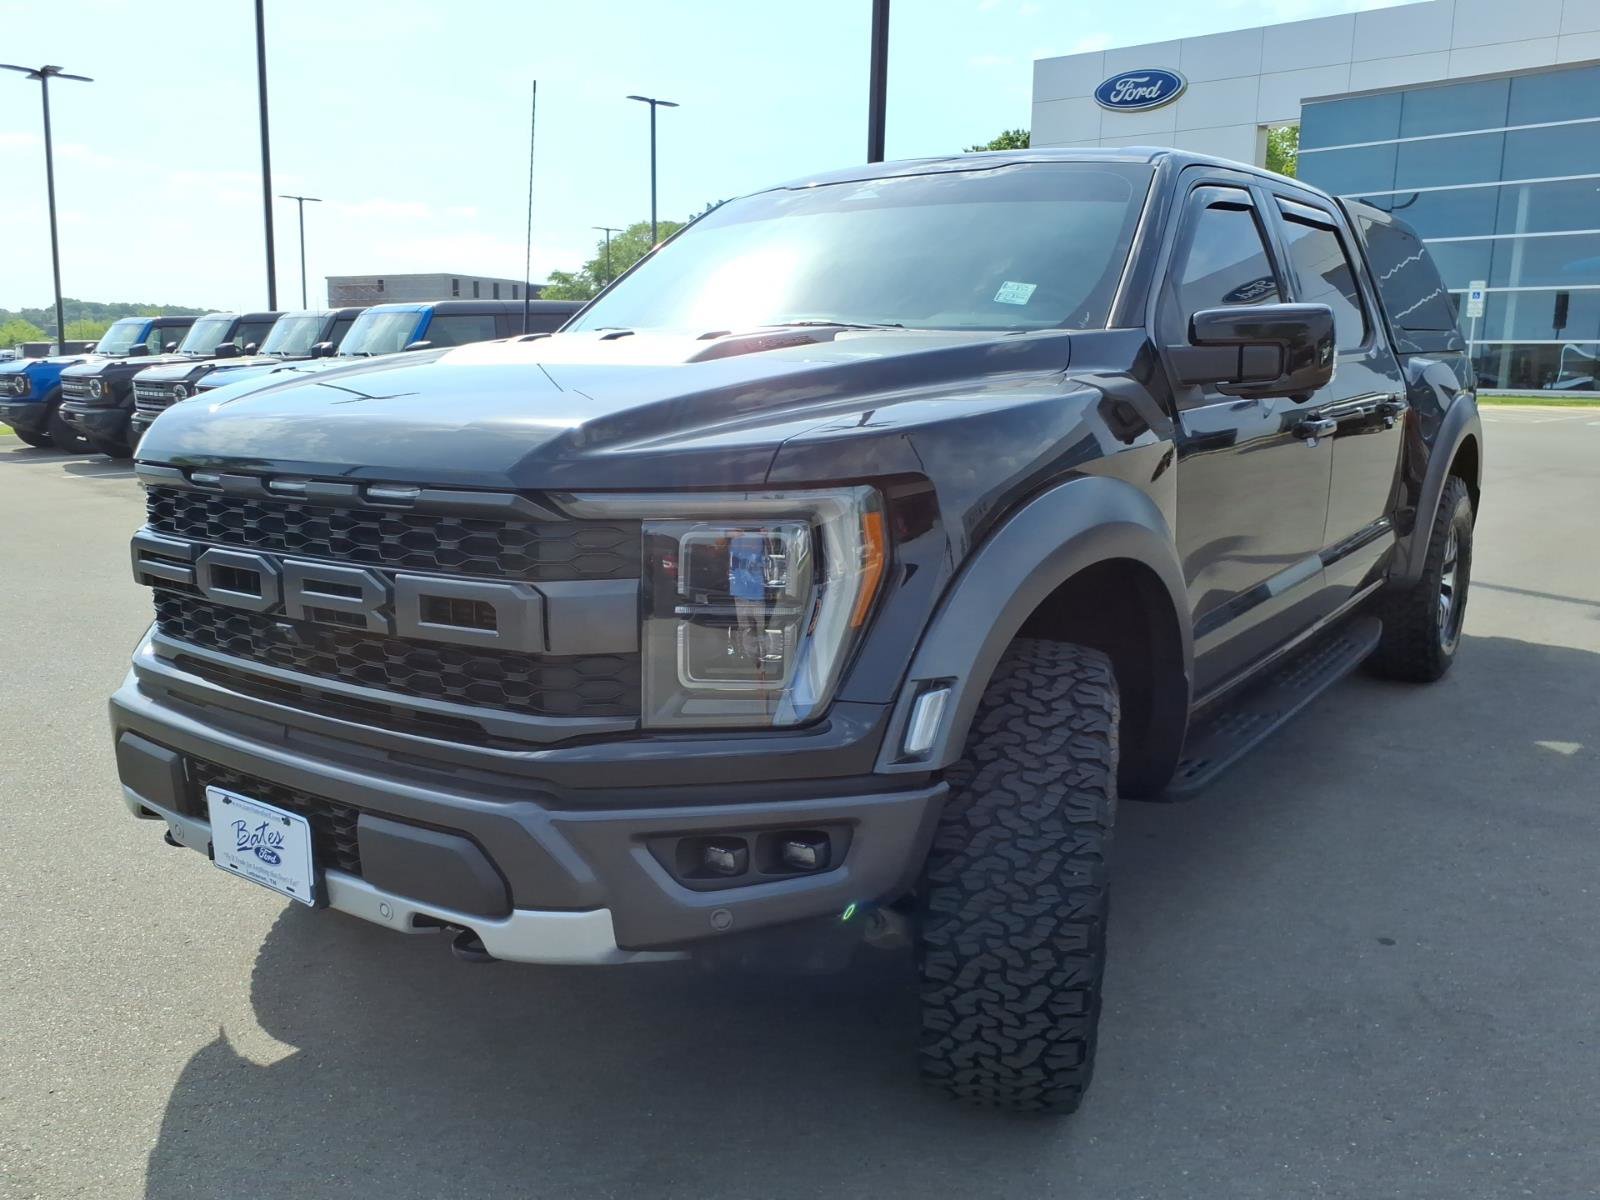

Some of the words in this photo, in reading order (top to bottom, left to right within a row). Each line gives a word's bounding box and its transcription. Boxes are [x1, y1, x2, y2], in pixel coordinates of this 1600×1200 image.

[1110, 76, 1163, 103] Ford
[131, 531, 543, 653] FORD
[231, 820, 285, 847] Bates
[258, 847, 277, 863] Ford
